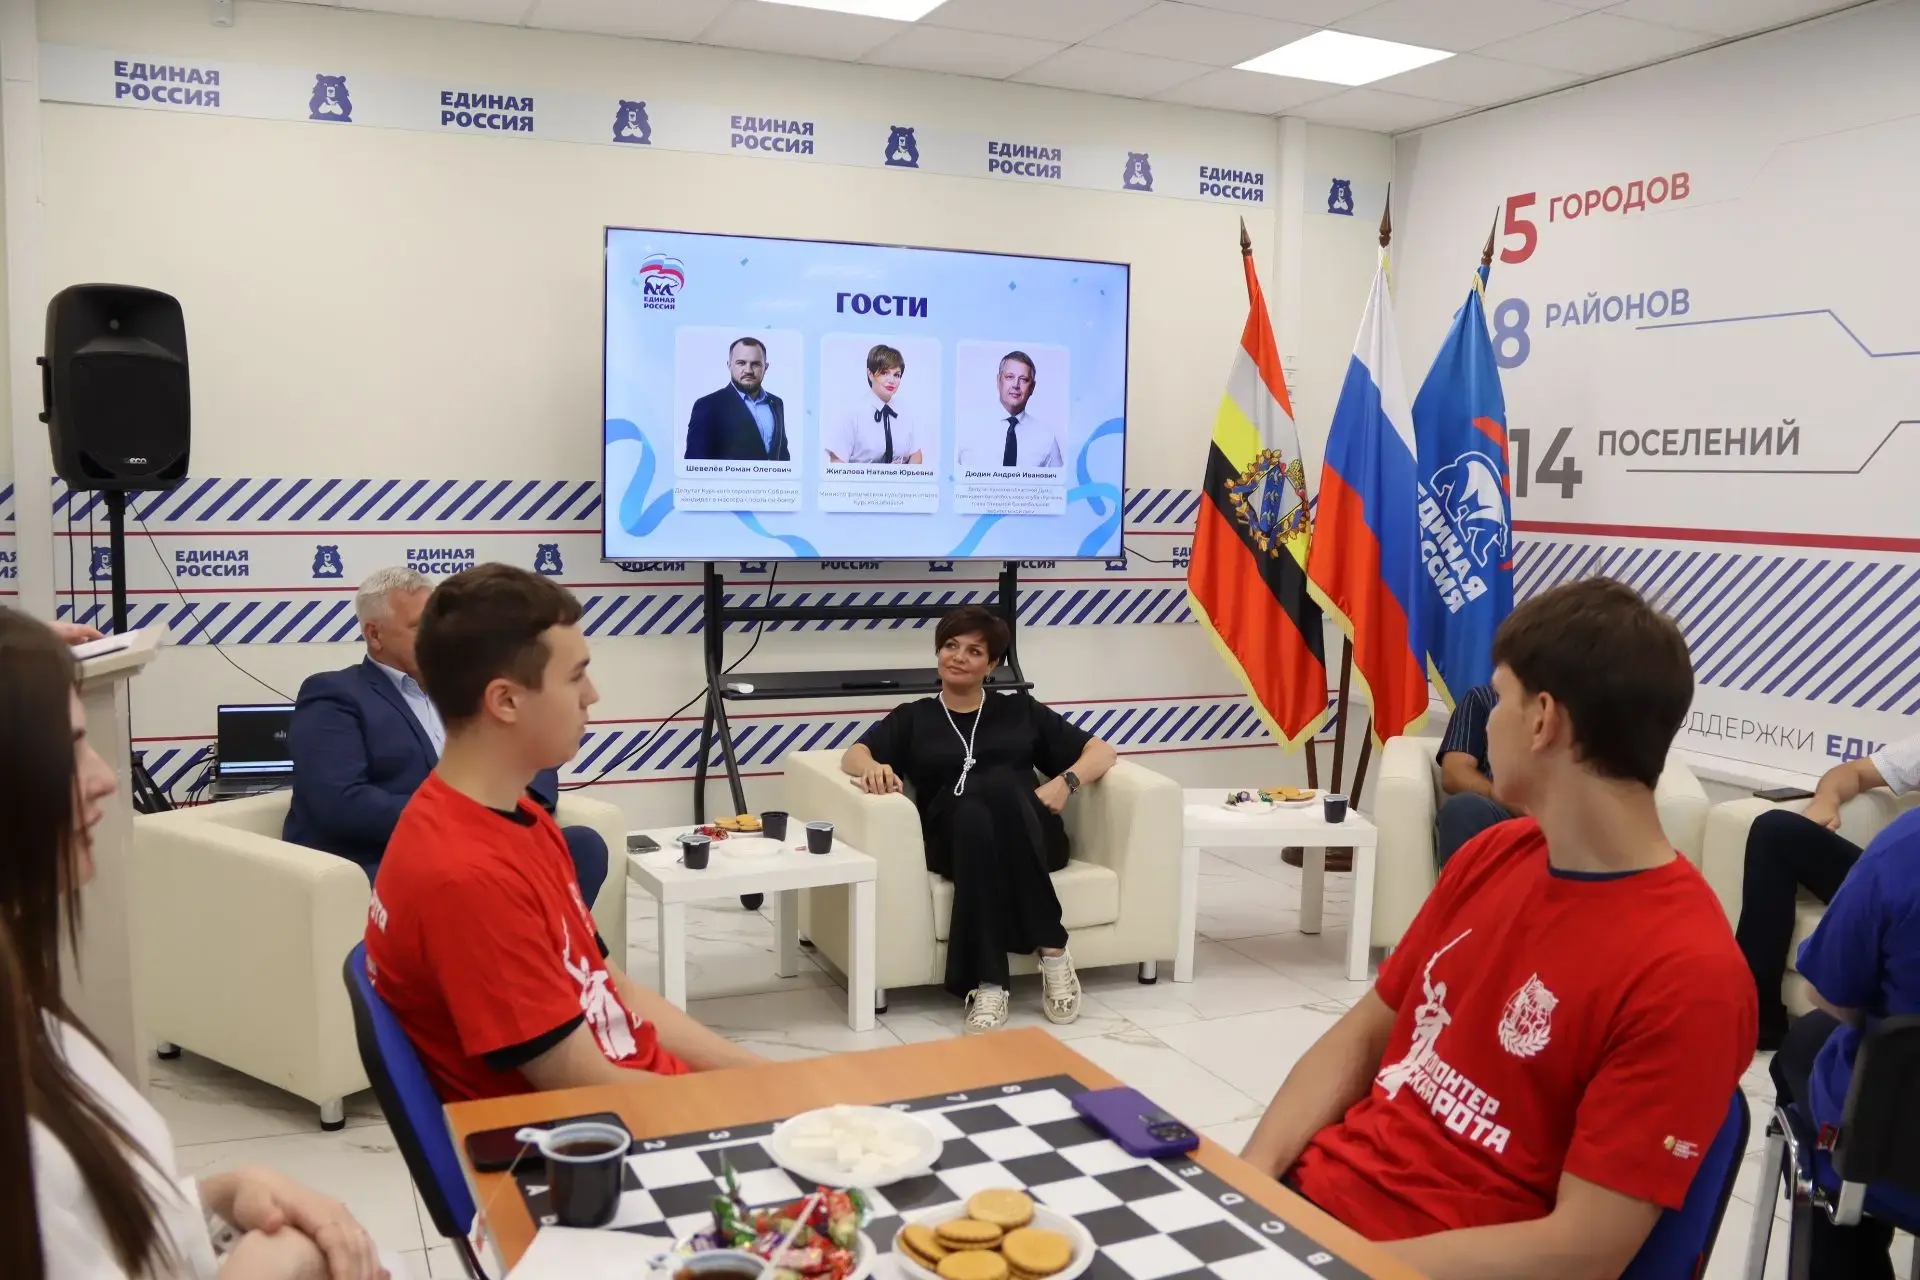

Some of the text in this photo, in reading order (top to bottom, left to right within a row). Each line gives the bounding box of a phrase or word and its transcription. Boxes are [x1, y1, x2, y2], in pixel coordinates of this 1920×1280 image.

[114, 60, 220, 86] ЕДИНАЯ
[115, 82, 220, 108] РОССИЯ
[440, 91, 533, 112] ЕДИНАЯ
[441, 110, 533, 132] РОССИЯ
[730, 115, 814, 136] ЕДИНАЯ
[731, 133, 814, 155] РОССИЯ
[988, 140, 1062, 162] ЕДИНАЯ
[988, 158, 1061, 179] РОССИЯ
[1200, 165, 1264, 186] ЕДИНАЯ
[1200, 181, 1263, 202] РОССИЯ
[1499, 172, 1691, 264] 5 ГОРОДОВ
[644, 296, 676, 304] ЕДИНАЯ
[836, 292, 928, 318] ГОСТИ
[1492, 287, 1691, 369] 8 РАЙОНОВ
[725, 465, 751, 473] Роман
[1509, 418, 1800, 499] 14 ПОСЕЛЕНИЙ
[899, 469, 934, 477] Юрьевна
[965, 470, 991, 478] Дюдин
[992, 471, 1021, 479] Андрей
[175, 550, 249, 563] ЕДИНАЯ
[407, 548, 475, 561] ЕДИНАЯ
[176, 564, 249, 577] РОССИЯ
[1419, 525, 1466, 614] ССИЯ
[1679, 711, 1814, 752] ДДЕРЖКИ
[1431, 1088, 1511, 1154] РОТА
[643, 1140, 667, 1150] 2
[708, 1130, 731, 1141] 3
[1179, 1166, 1203, 1178] E
[525, 1184, 551, 1196] A
[1219, 1192, 1245, 1206] D
[1260, 1220, 1285, 1234] C
[1307, 1251, 1334, 1266] B
